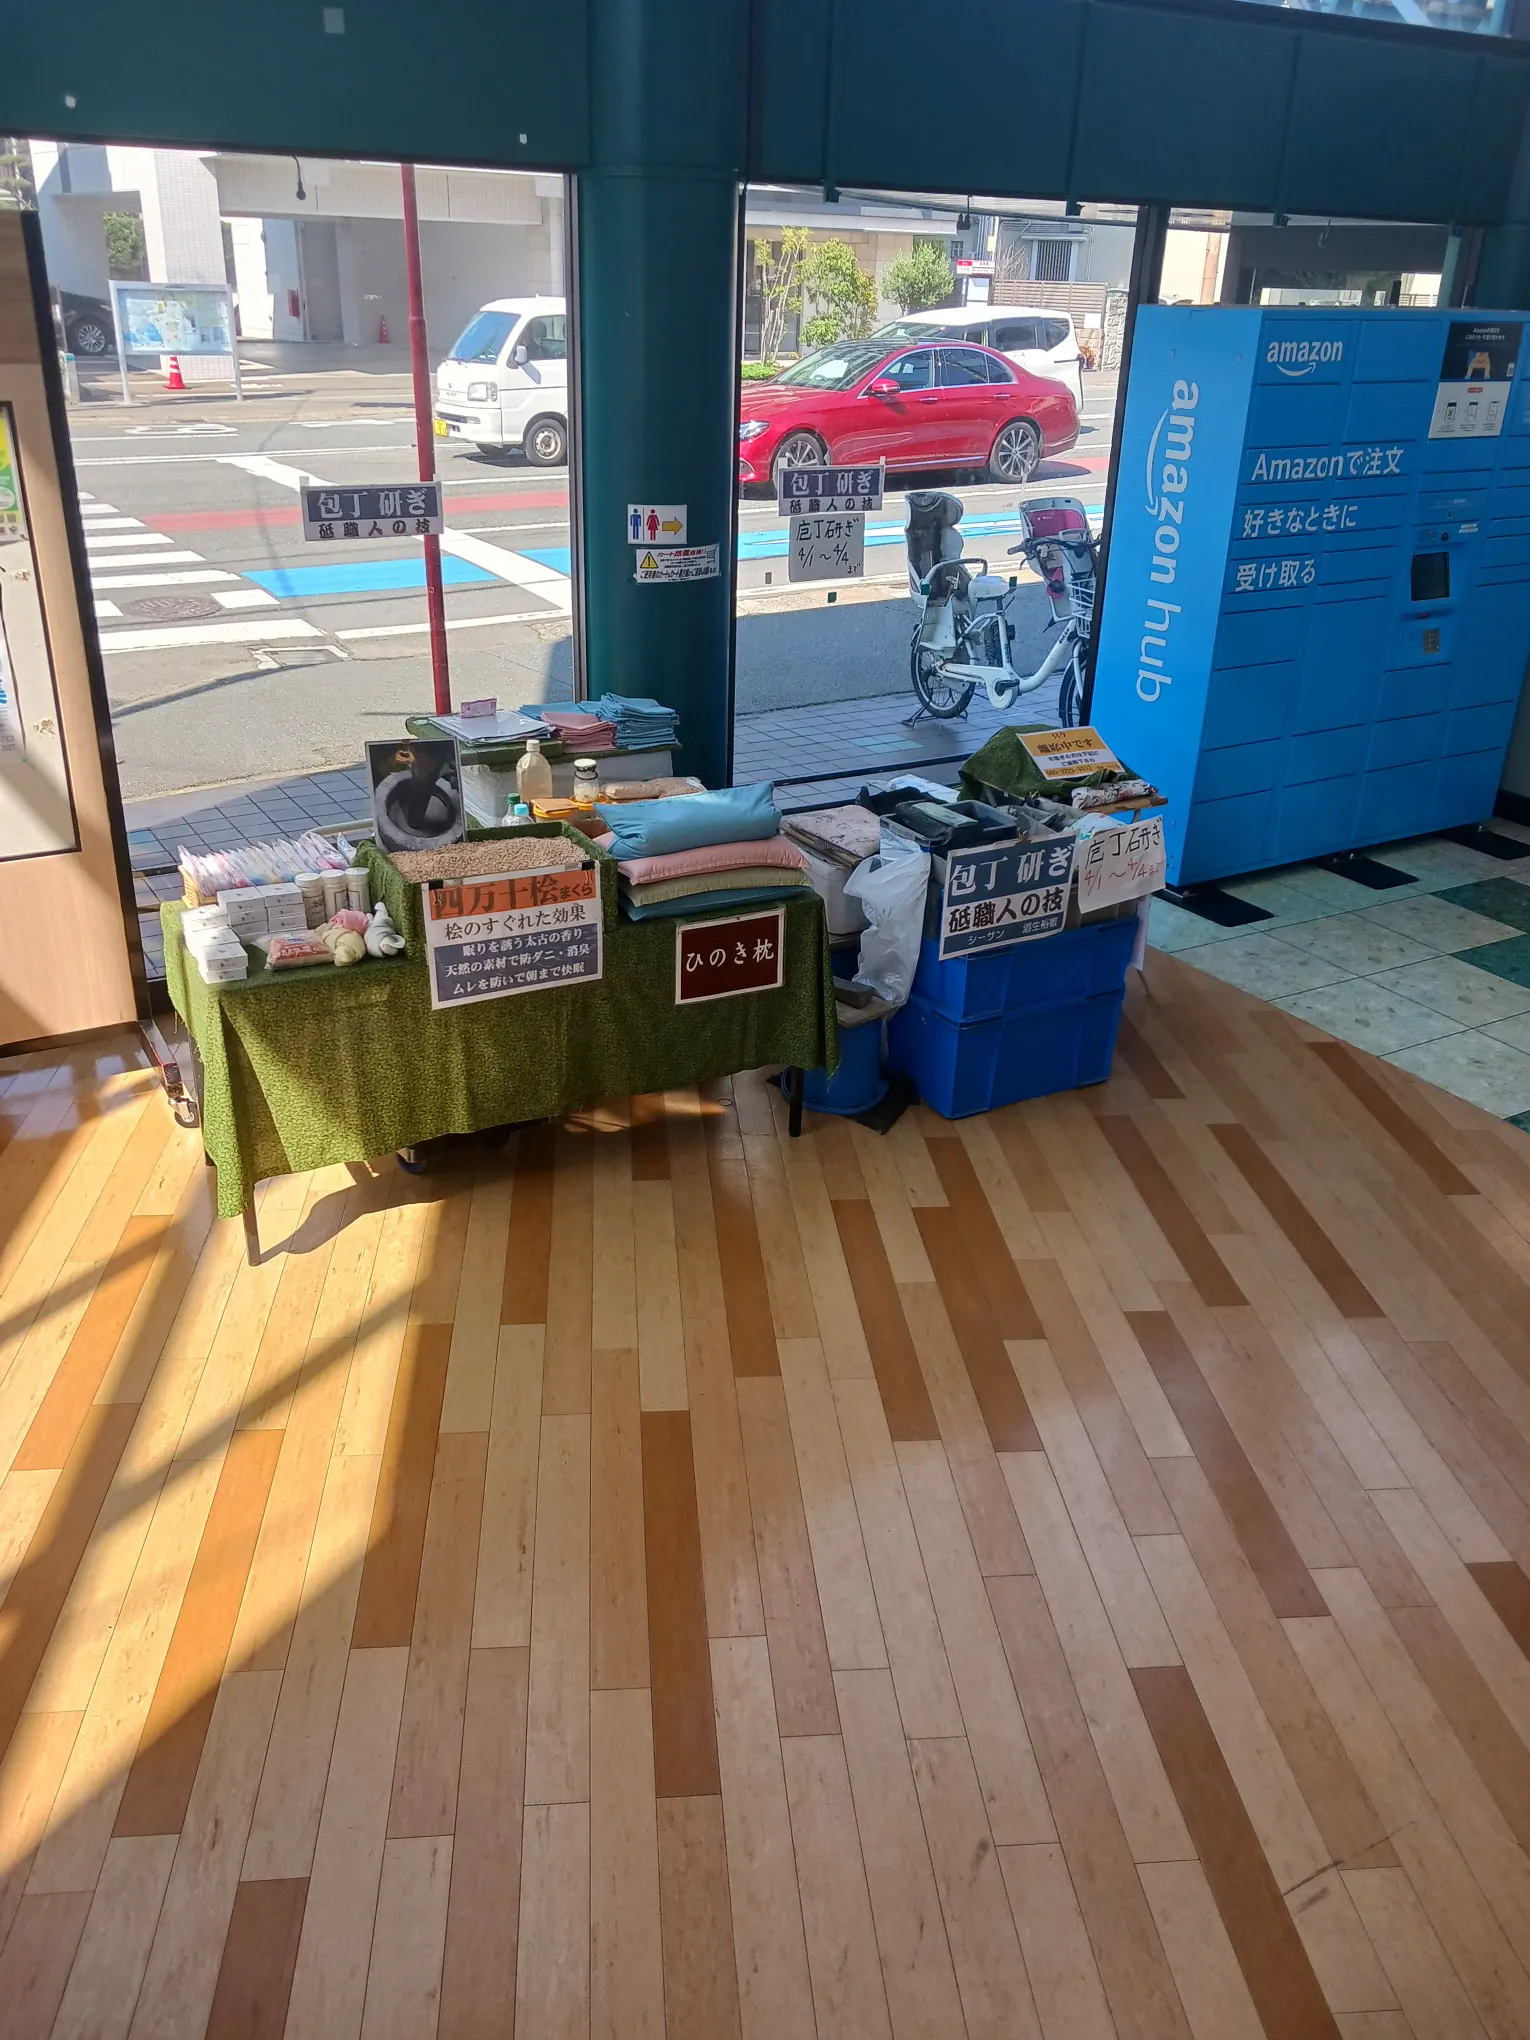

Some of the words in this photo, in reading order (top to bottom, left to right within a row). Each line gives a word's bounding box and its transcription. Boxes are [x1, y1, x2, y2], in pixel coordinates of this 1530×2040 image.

[1267, 340, 1343, 363] amazon
[1150, 379, 1199, 584] amazon
[1251, 446, 1404, 482] Amazonで注文
[1242, 504, 1358, 538] 好きなときに
[1235, 559, 1316, 592] 受け取る
[1135, 598, 1182, 702] hub
[445, 904, 587, 941] 桧のすぐれた効果
[949, 887, 1065, 934] 砥職人の技
[462, 927, 583, 957] 眠りを誘う太古の香り
[968, 929, 1005, 945] シーサン
[444, 943, 591, 978] 天然の素材で防ダニ・消臭
[686, 938, 774, 973] ひのき枕
[453, 961, 585, 995] ムレを防いで朝まで快眠
